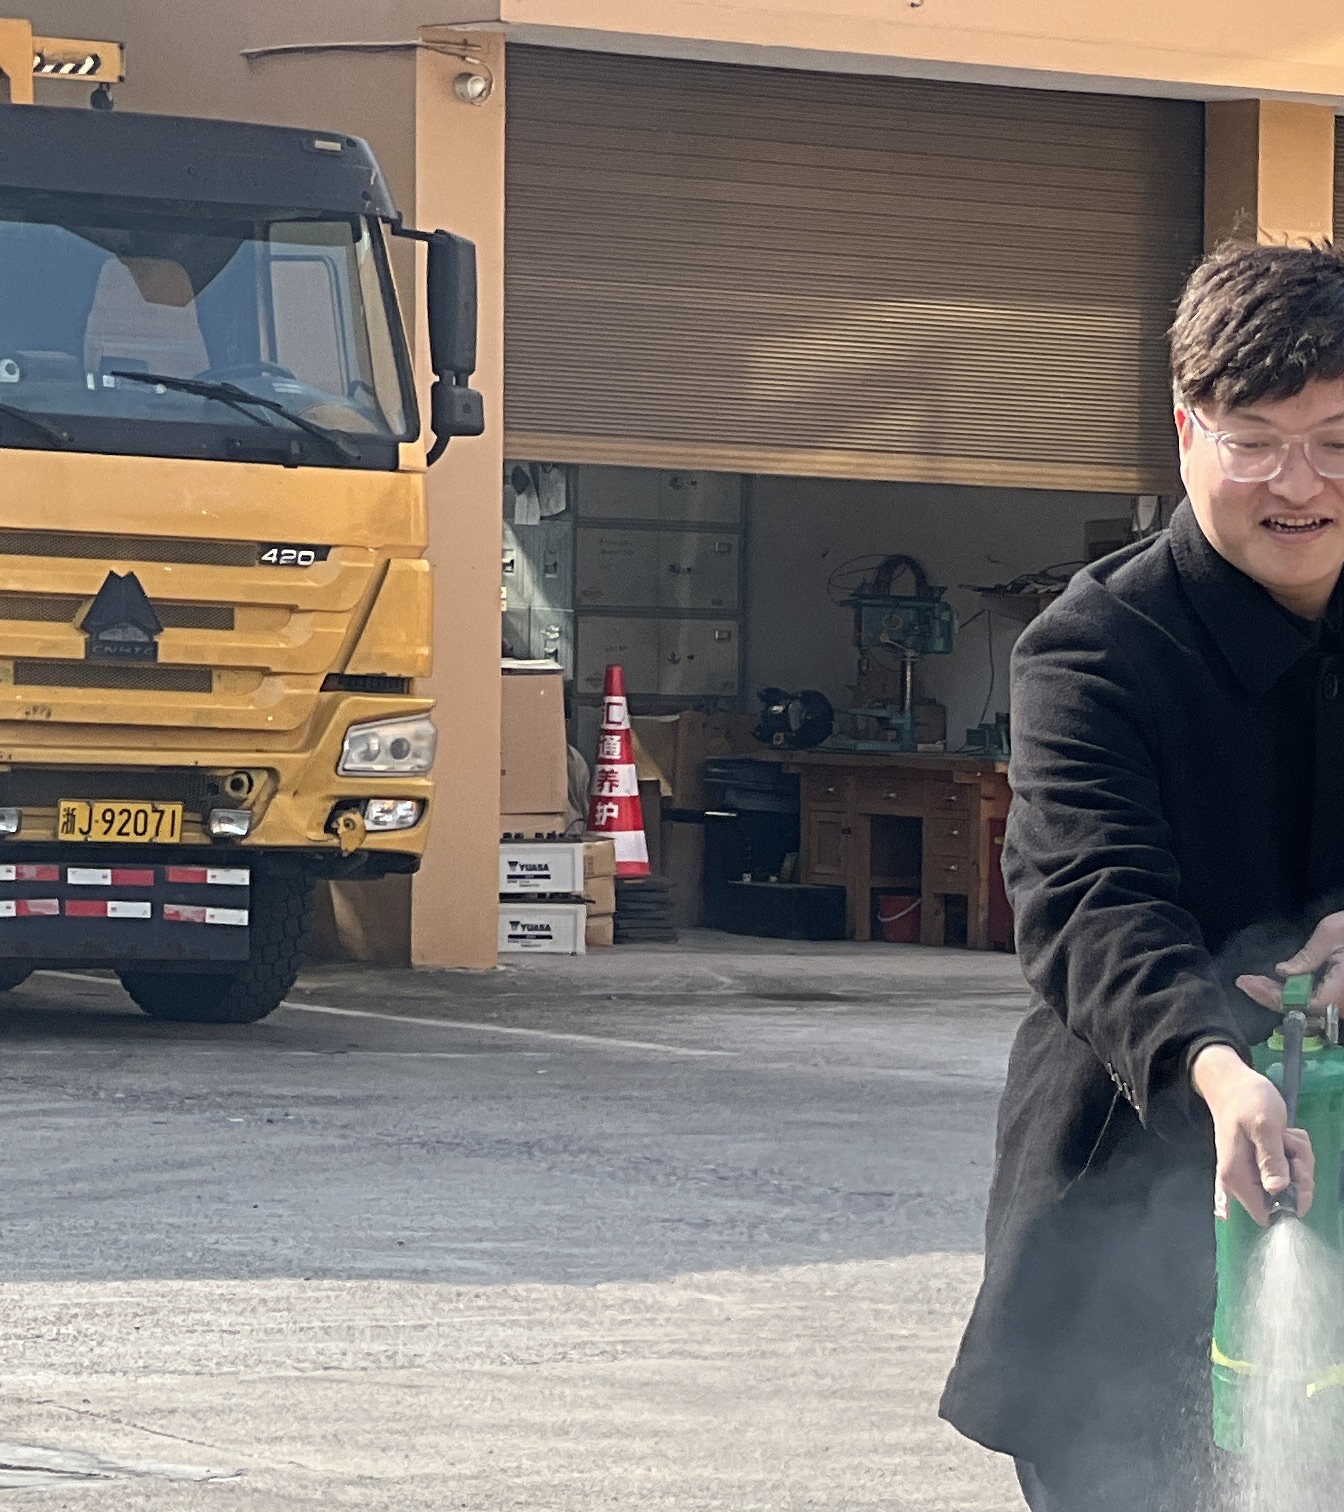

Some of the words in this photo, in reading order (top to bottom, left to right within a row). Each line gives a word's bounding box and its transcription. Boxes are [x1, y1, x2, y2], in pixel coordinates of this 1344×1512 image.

[261, 548, 315, 566] 420
[520, 863, 550, 872] YUASA
[521, 923, 551, 932] YUASA
